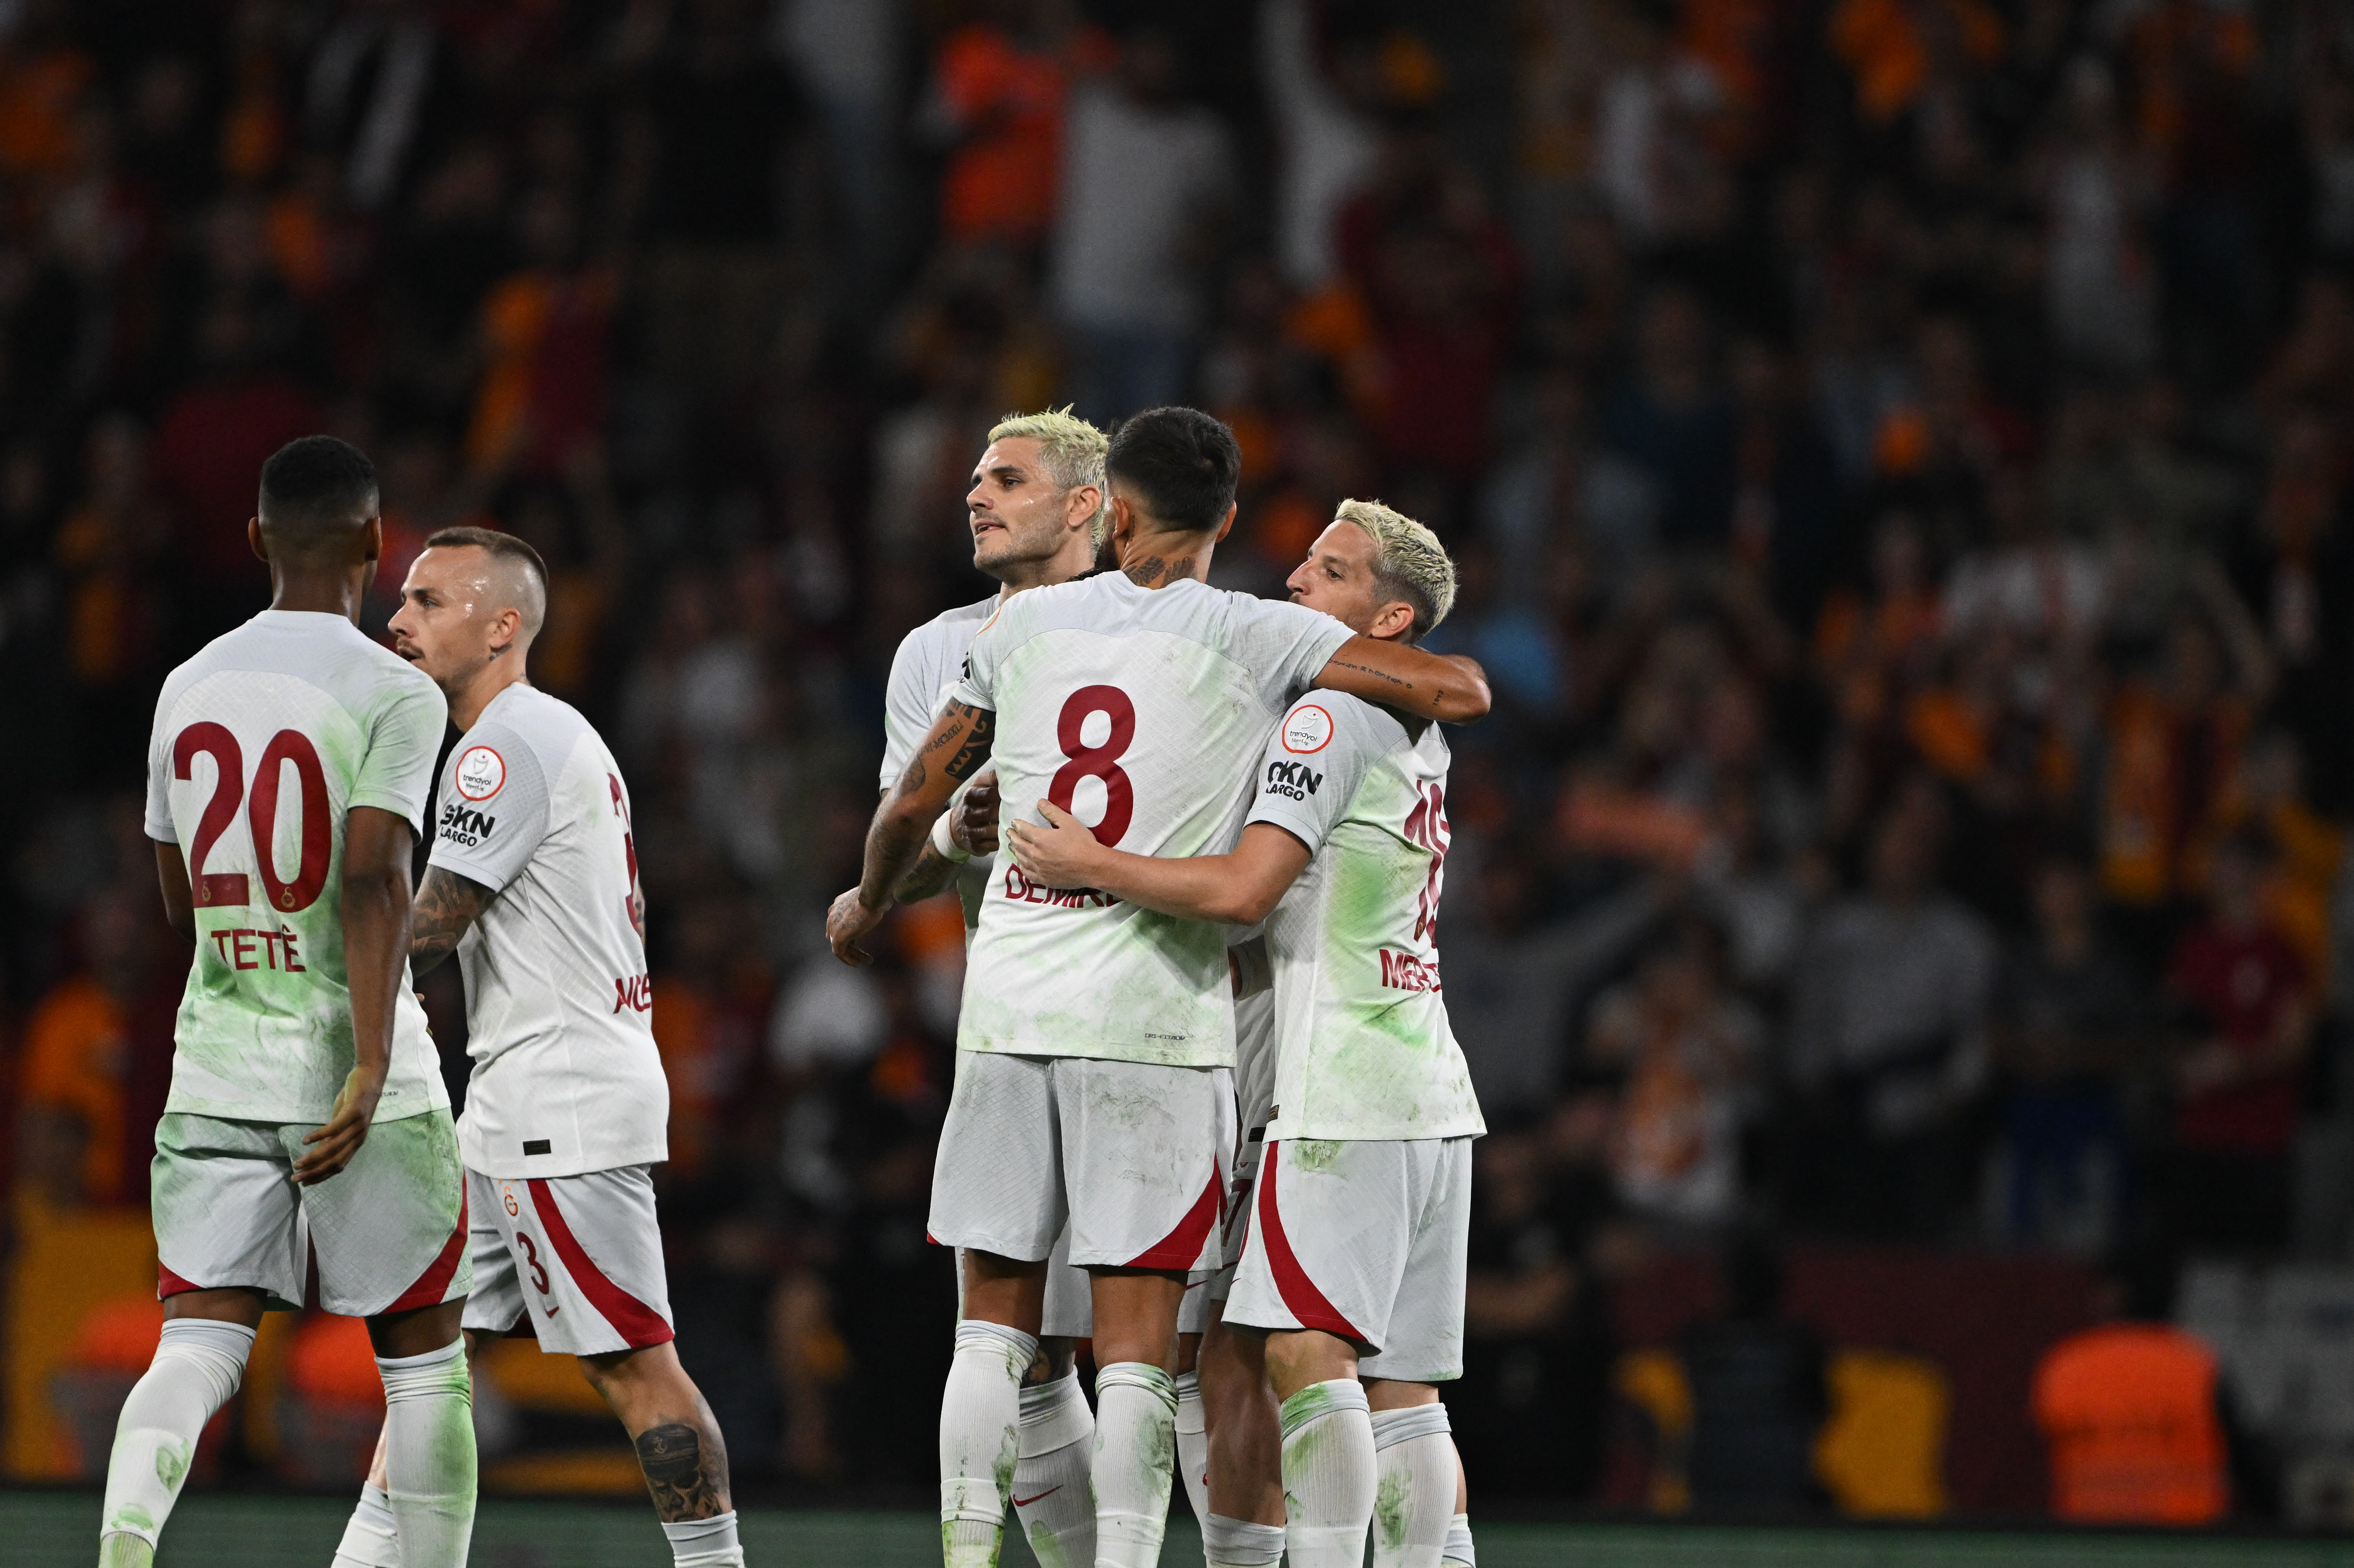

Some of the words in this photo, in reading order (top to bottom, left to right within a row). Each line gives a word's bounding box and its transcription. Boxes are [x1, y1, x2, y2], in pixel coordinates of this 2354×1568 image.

[1290, 730, 1318, 742] trendyol
[463, 774, 492, 785] trendyol
[1048, 684, 1136, 848] 8
[173, 721, 332, 913] 20
[211, 923, 306, 972] TETÊ
[516, 1231, 549, 1295] 3
